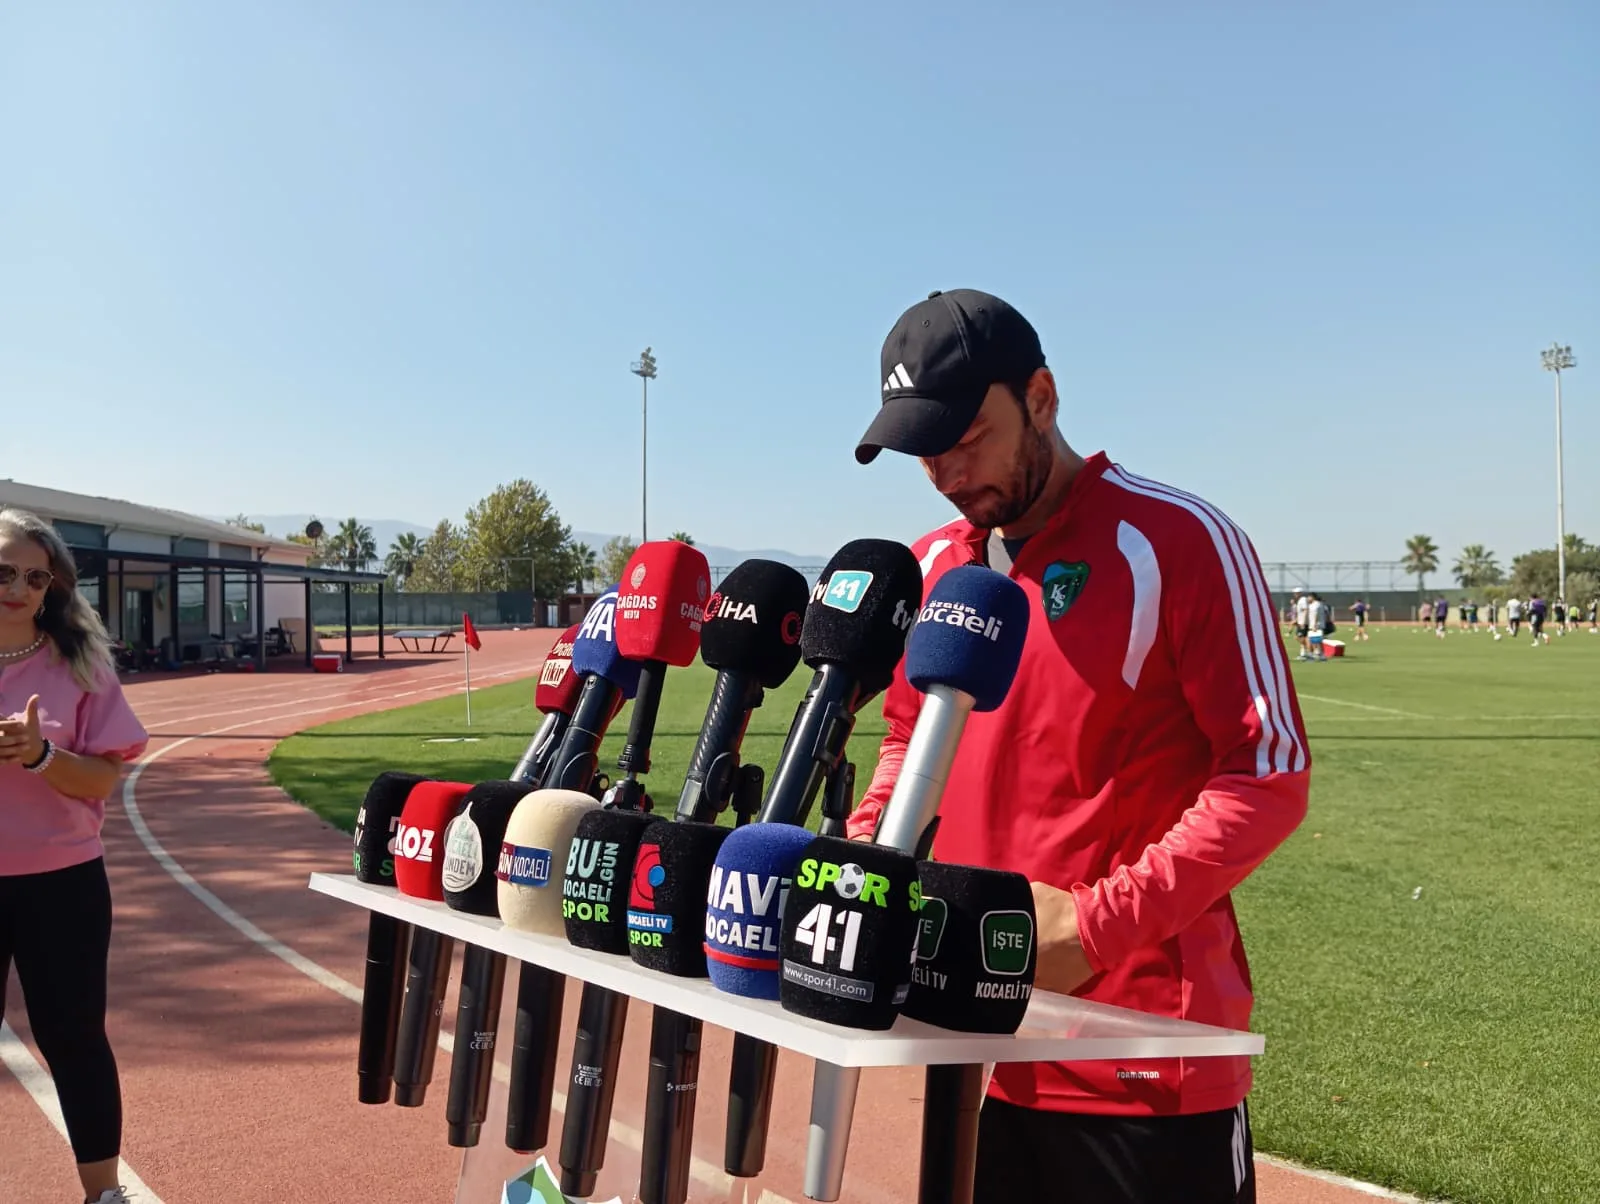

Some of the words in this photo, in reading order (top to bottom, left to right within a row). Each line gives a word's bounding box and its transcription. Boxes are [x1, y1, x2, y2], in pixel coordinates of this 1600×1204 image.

[830, 578, 861, 602] 41
[576, 603, 615, 641] AA
[717, 596, 758, 624] İHA
[512, 855, 551, 880] KOCAELİ
[797, 858, 890, 908] SPOR
[562, 898, 610, 923] SPOR
[656, 917, 668, 929] TV
[630, 929, 663, 948] SPOR
[705, 911, 777, 952] OCAEL
[795, 903, 863, 972] 41
[992, 929, 1024, 950] İŞTE
[783, 964, 867, 997] www.spor41.com
[975, 980, 1020, 1000] KOCAELİ
